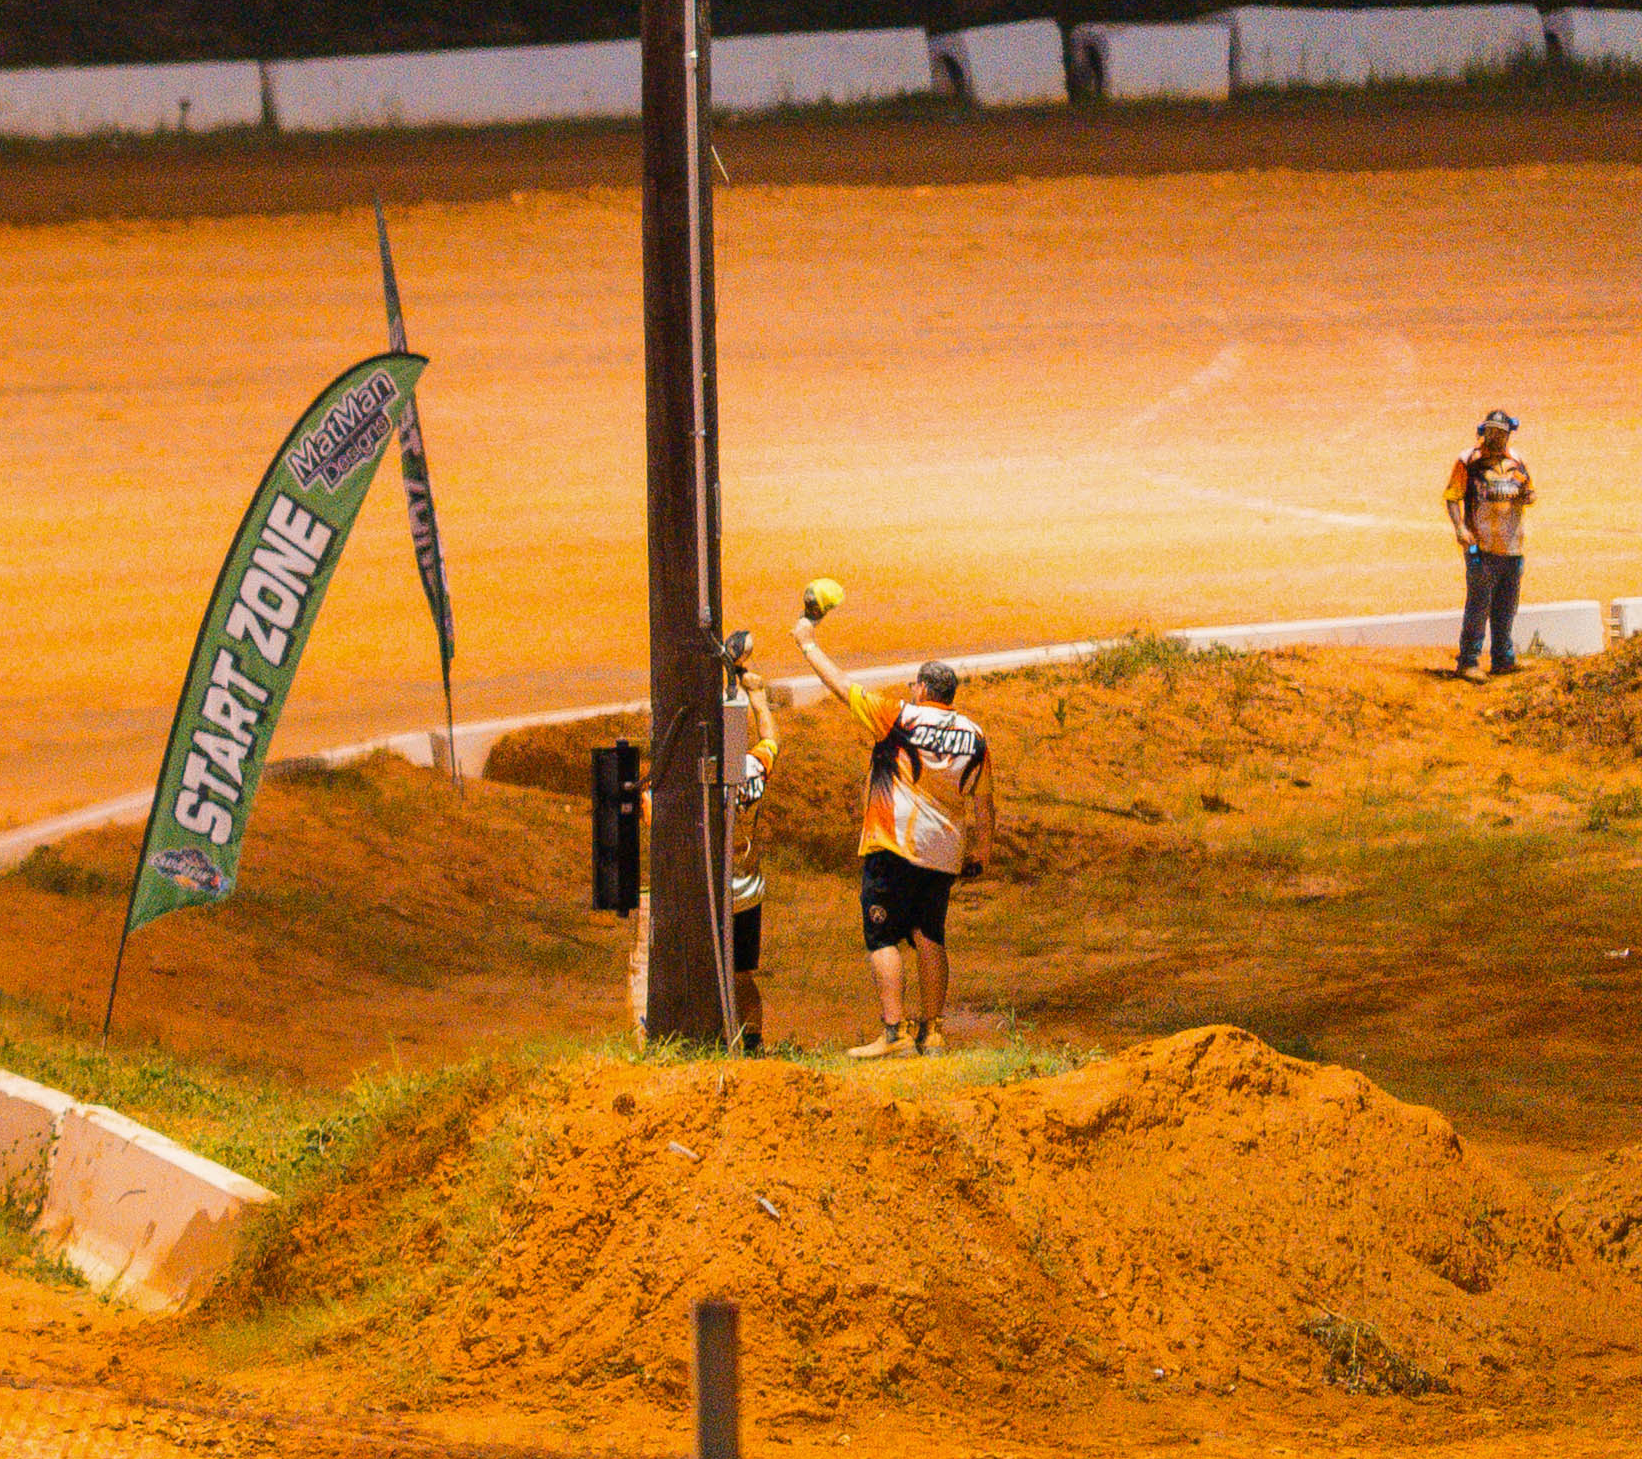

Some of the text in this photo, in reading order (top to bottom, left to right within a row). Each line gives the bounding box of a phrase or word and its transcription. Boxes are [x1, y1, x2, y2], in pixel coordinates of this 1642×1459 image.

[287, 374, 395, 485] MatMan
[175, 655, 271, 845] START
[226, 493, 334, 668] ZONE
